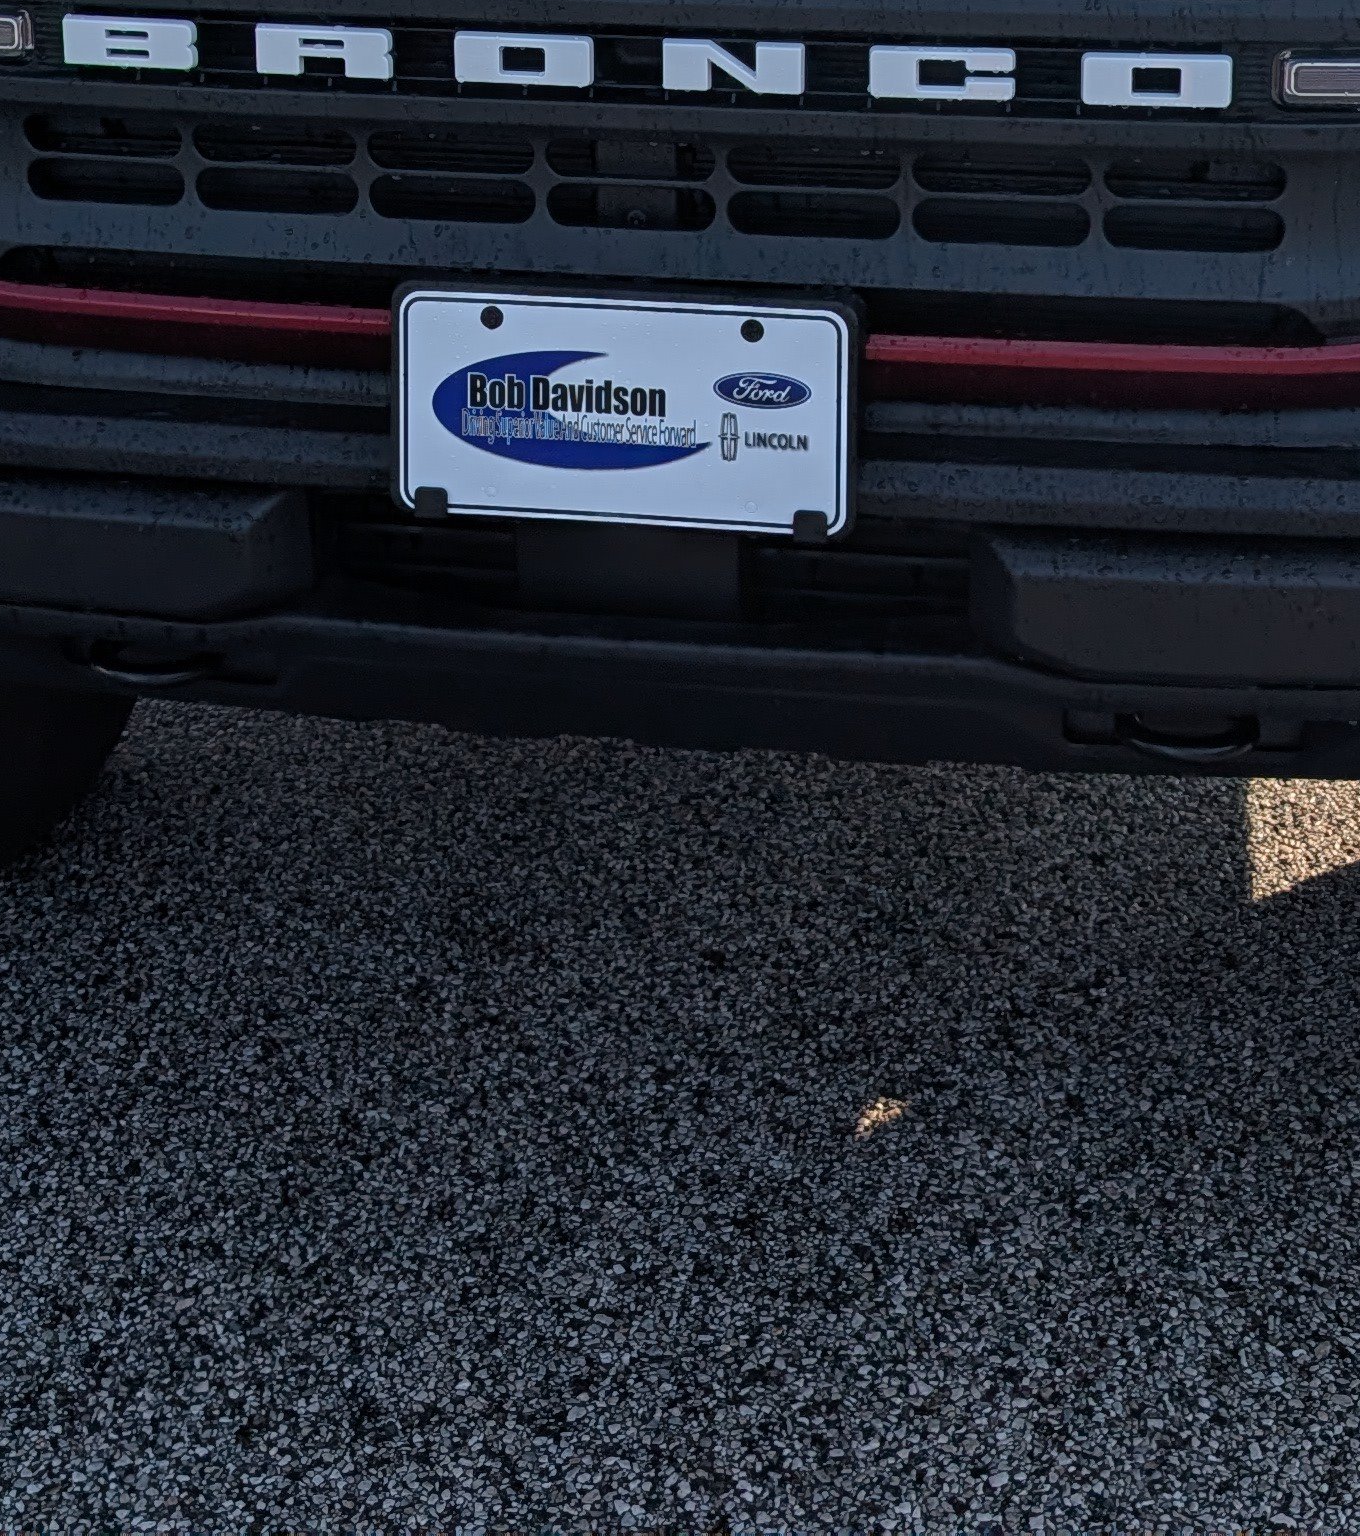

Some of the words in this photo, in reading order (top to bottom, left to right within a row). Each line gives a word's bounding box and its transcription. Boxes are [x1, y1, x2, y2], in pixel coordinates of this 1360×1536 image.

[62, 13, 1233, 109] BRONCO
[467, 372, 525, 411] Bob
[530, 375, 667, 418] Davidson
[732, 376, 792, 403] Ford
[580, 415, 625, 444] Customer
[625, 417, 657, 446] Service
[658, 420, 697, 448] Forward
[744, 431, 809, 451] LINCOLN
